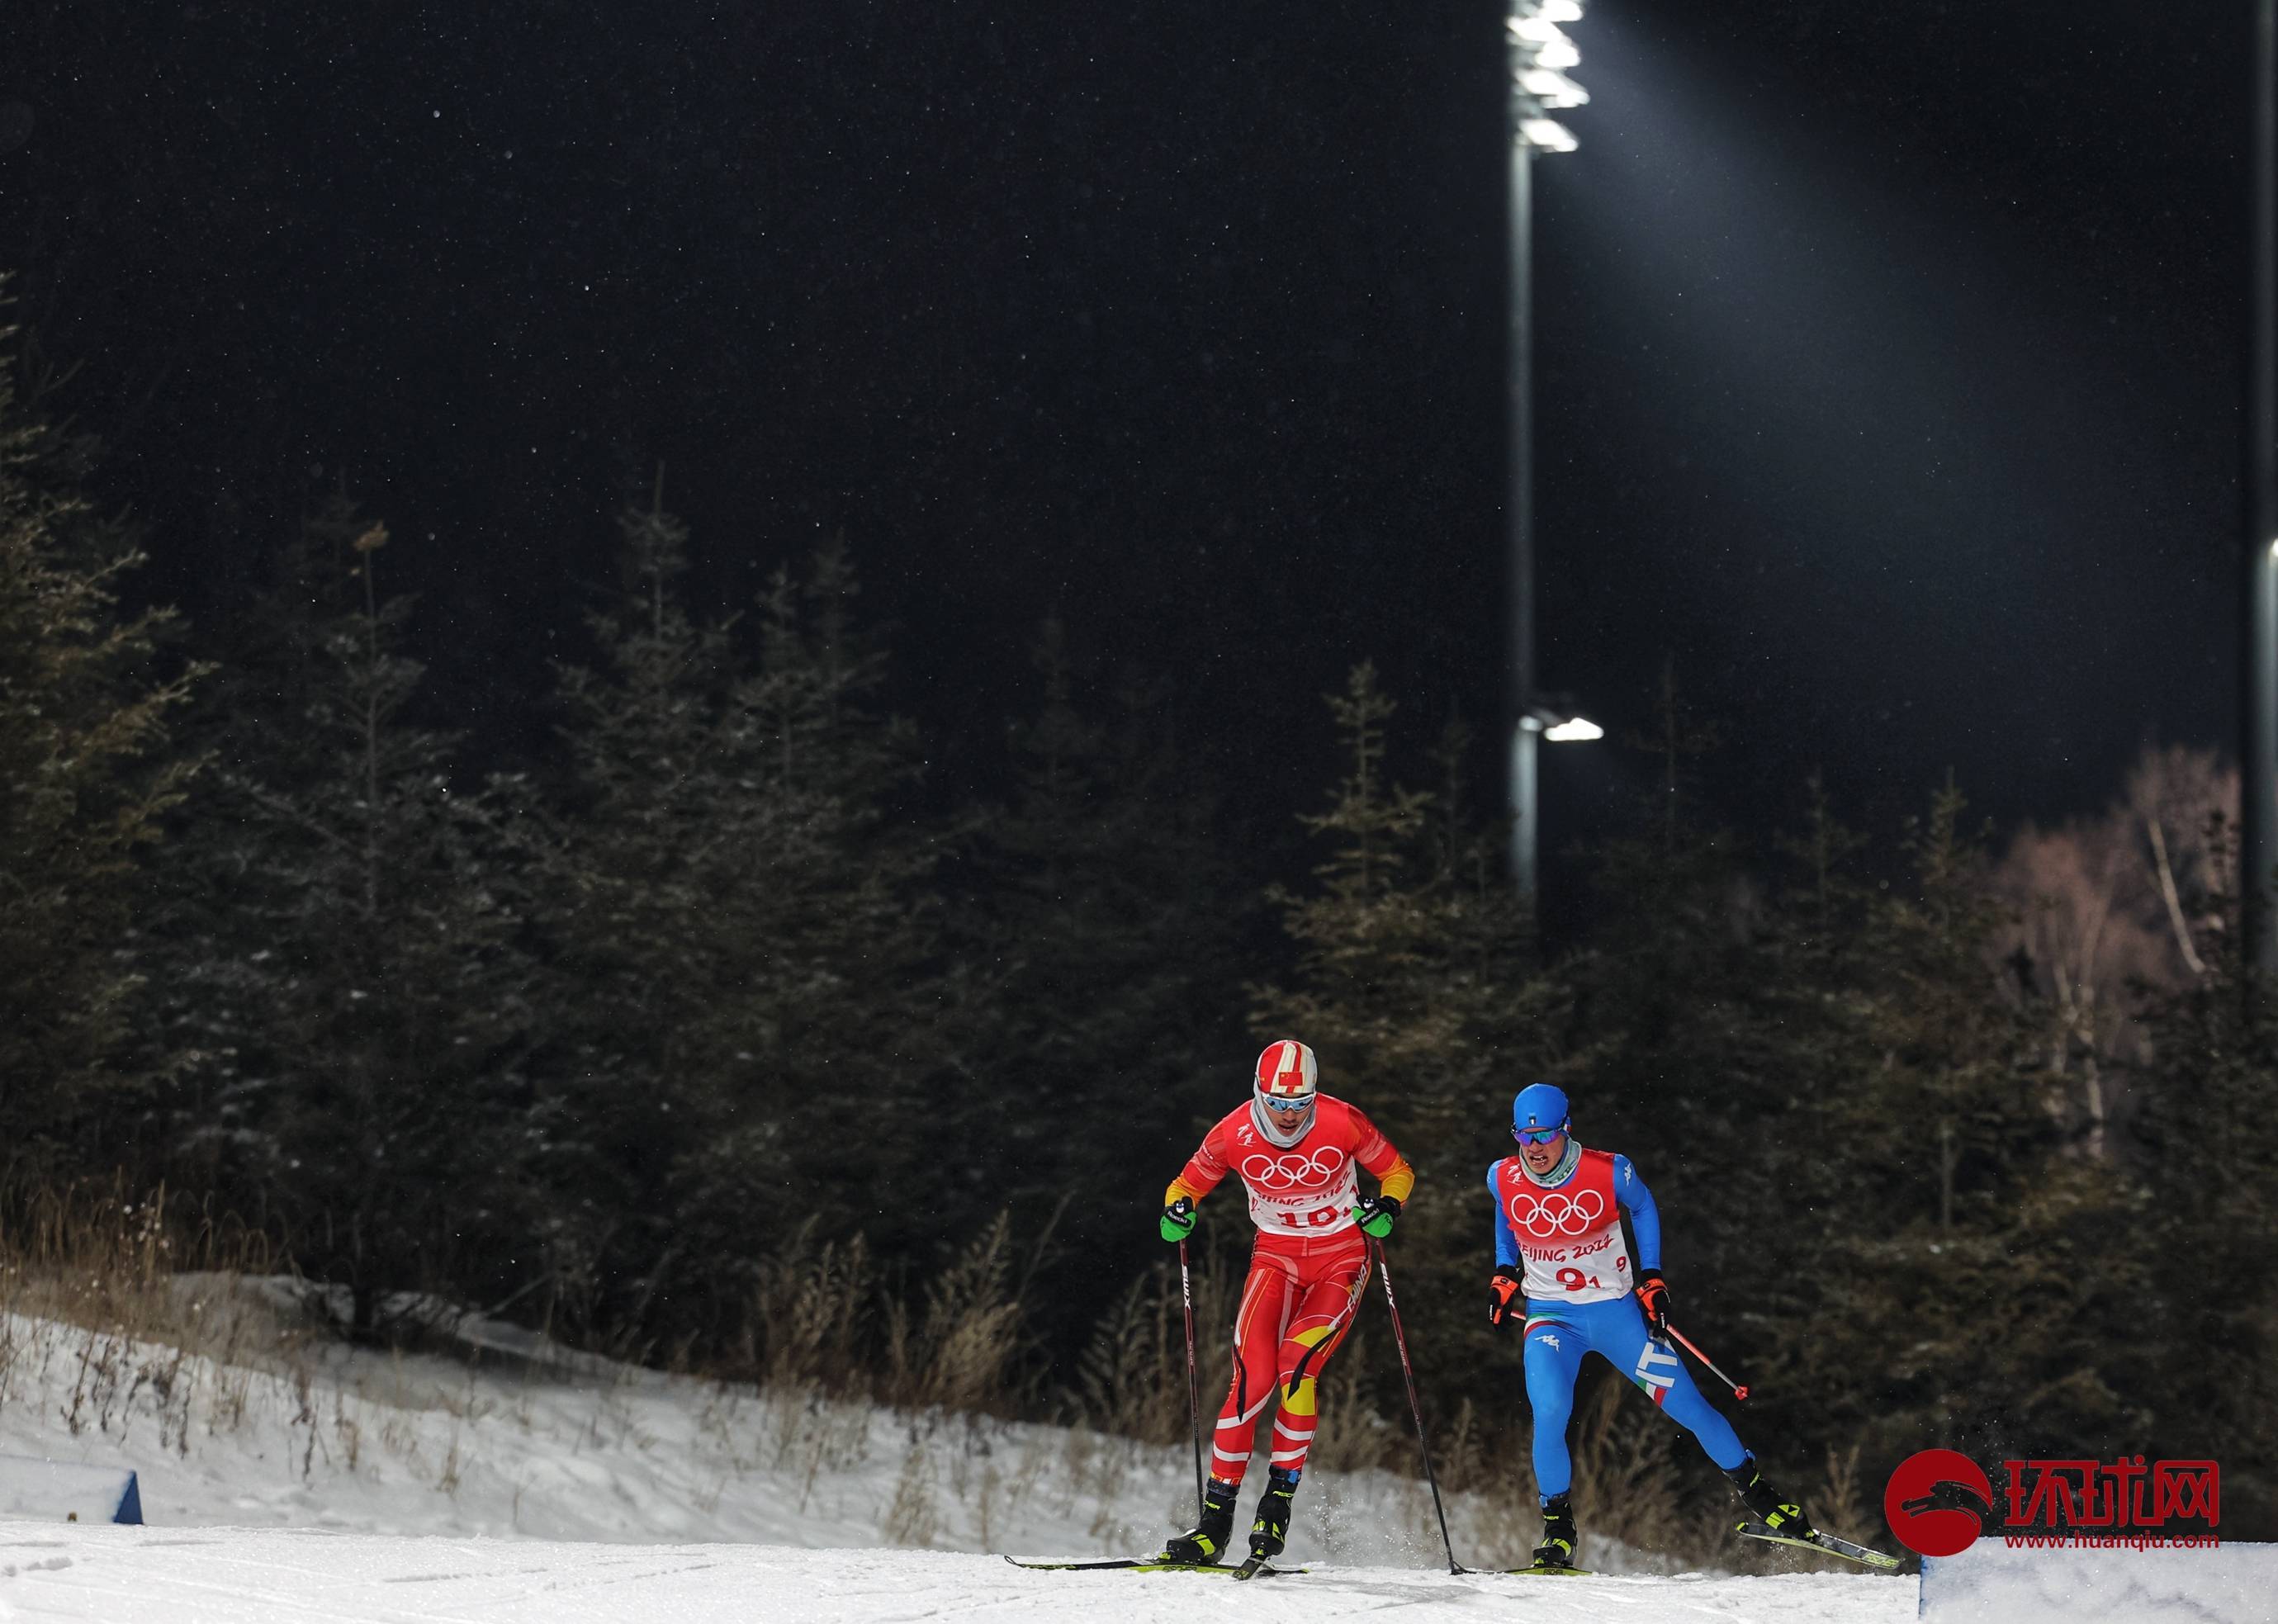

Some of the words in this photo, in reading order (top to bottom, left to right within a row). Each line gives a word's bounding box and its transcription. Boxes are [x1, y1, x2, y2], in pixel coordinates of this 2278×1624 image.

[1276, 1205, 1338, 1229] 10
[1518, 1240, 1566, 1262] EIJING
[1572, 1234, 1614, 1259] 2022
[1616, 1256, 1627, 1272] 9
[1556, 1267, 1587, 1291] 9
[1589, 1276, 1601, 1289] 1
